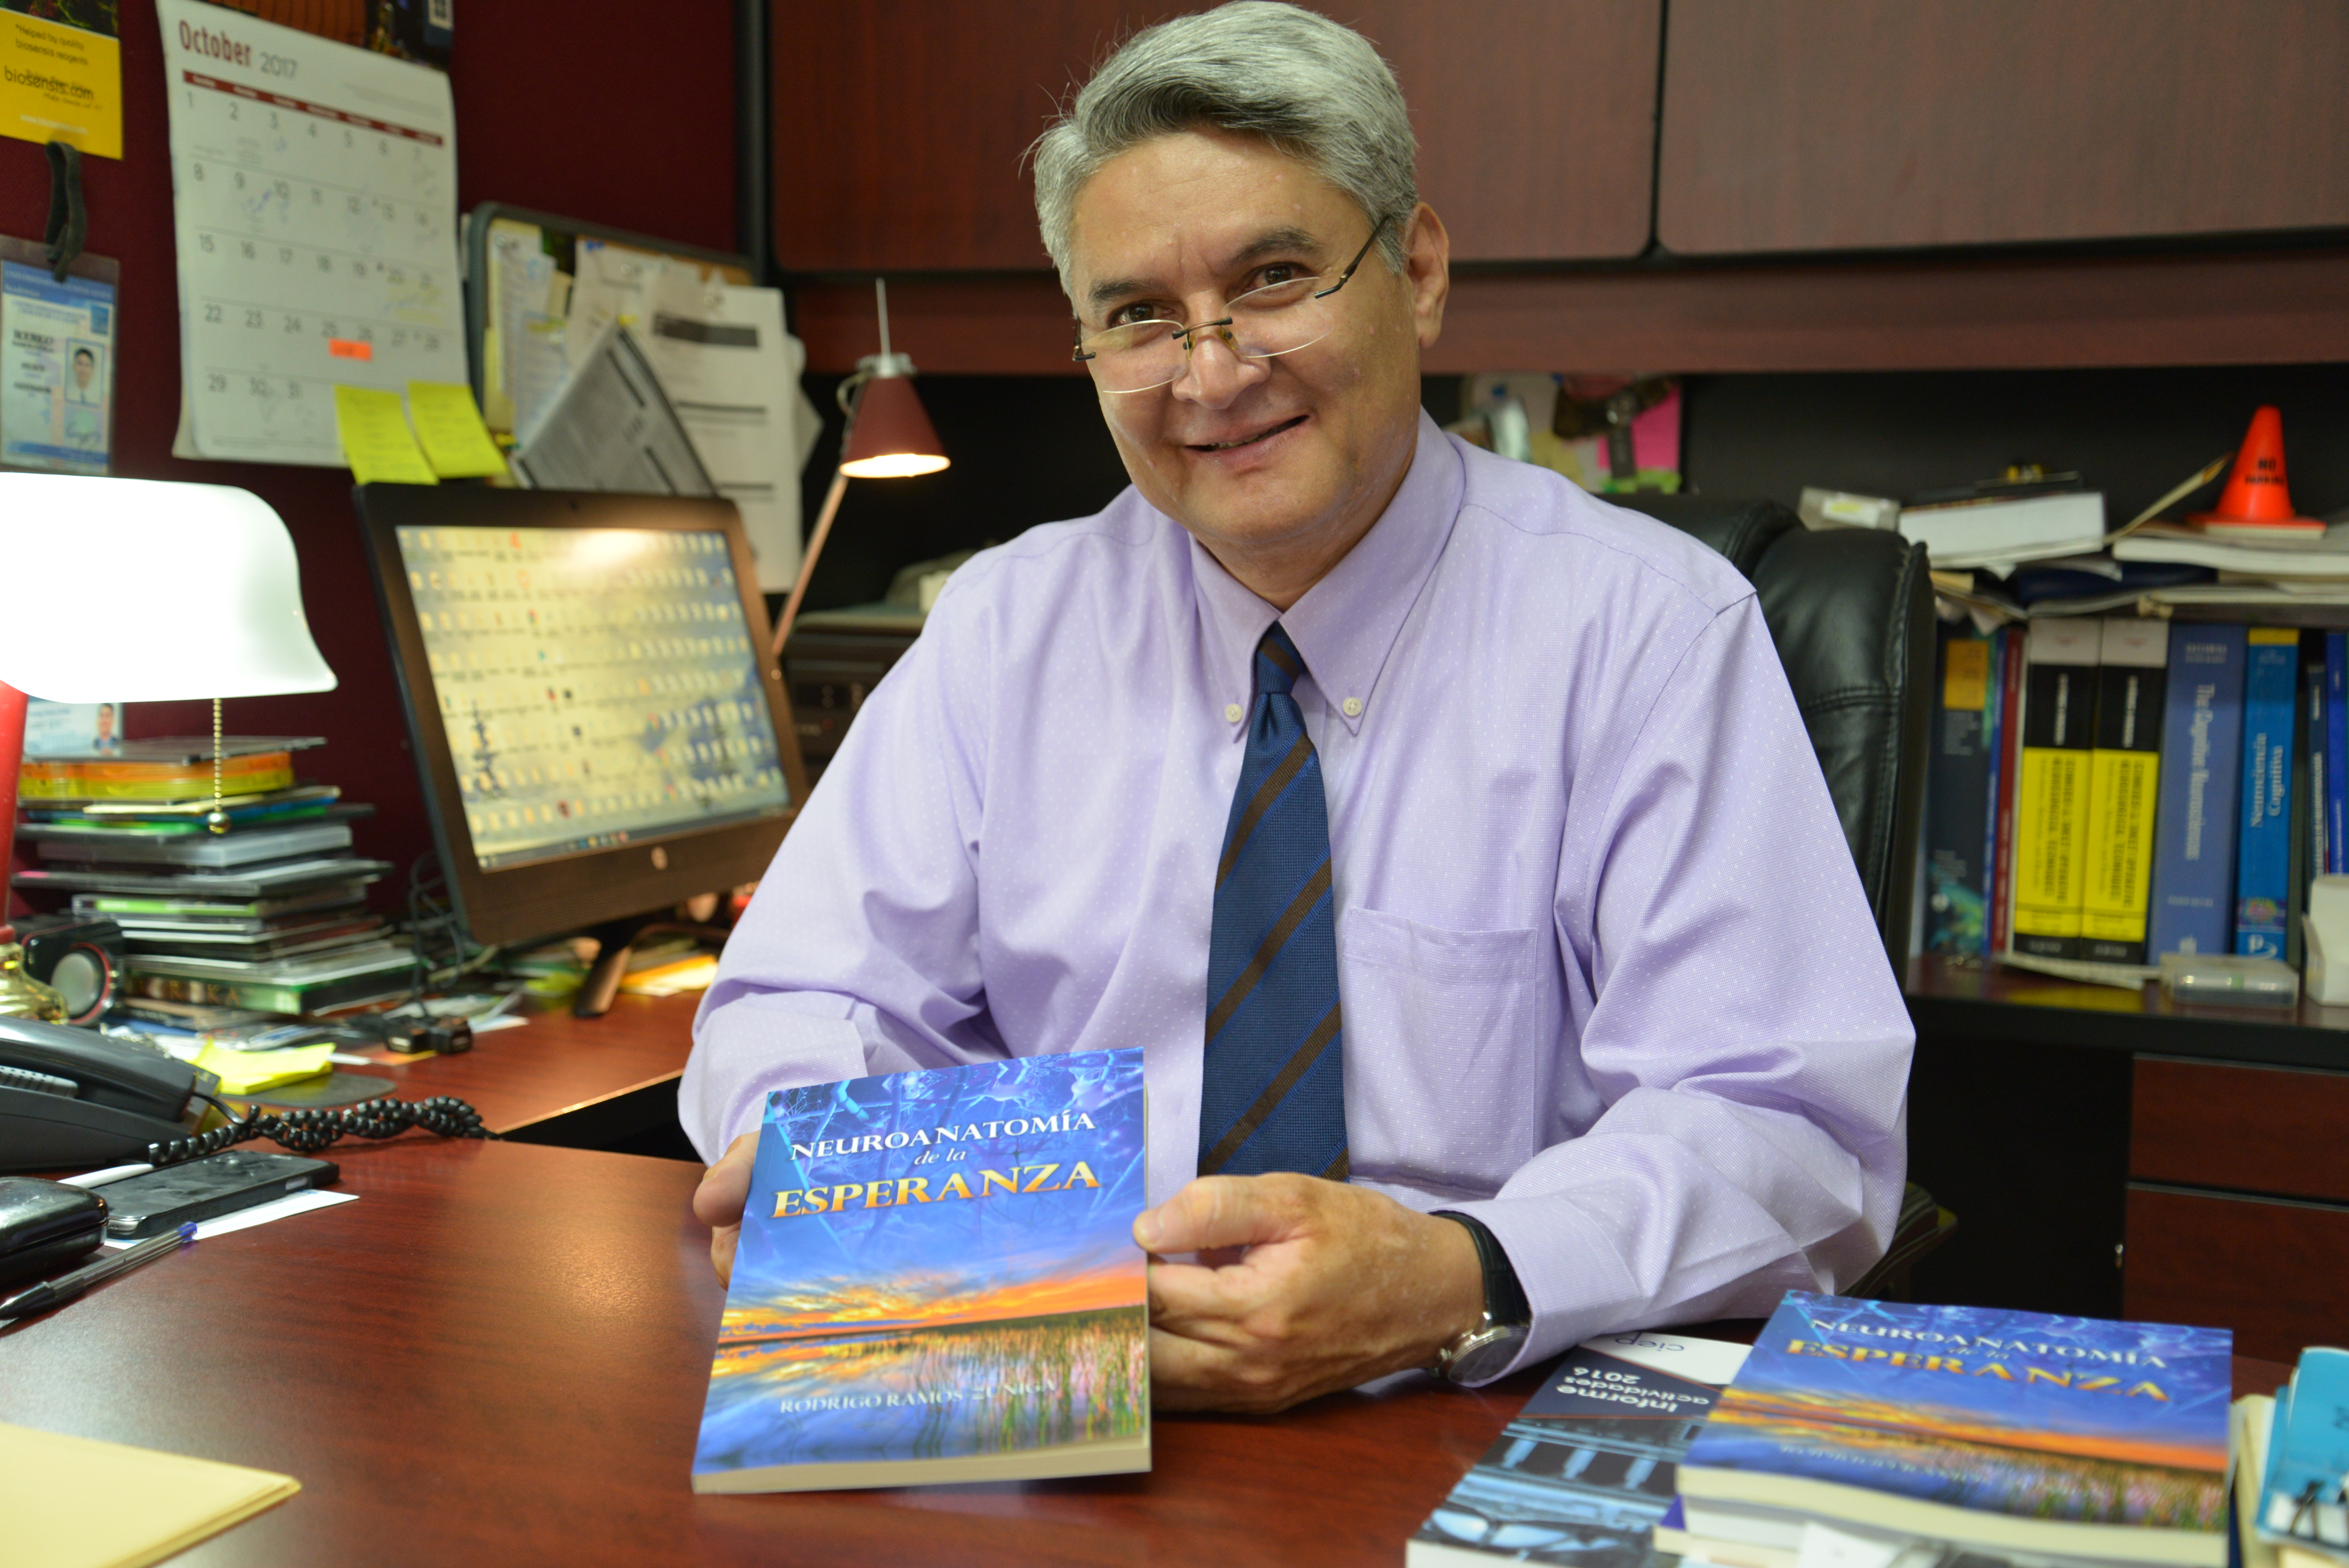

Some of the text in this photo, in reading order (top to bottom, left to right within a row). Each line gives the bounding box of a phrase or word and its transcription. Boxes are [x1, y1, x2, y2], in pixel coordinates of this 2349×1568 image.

[178, 19, 298, 78] October 2017
[186, 91, 194, 108] 1
[228, 101, 240, 121] 2
[269, 111, 279, 130] 3
[307, 122, 317, 137] 4
[194, 162, 205, 182] 8
[235, 171, 246, 190] 9
[274, 179, 290, 201] 10
[200, 233, 215, 253] 15
[203, 303, 223, 324] 22
[244, 309, 264, 330] 23
[283, 314, 303, 334] 24
[207, 372, 228, 392] 29
[2258, 456, 2276, 472] NO
[2268, 745, 2286, 816] Cognitiva
[790, 1109, 1096, 1161] NEUROANATOMÍA
[914, 1148, 967, 1165] de la
[770, 1160, 1102, 1219] ESPERANZA
[1615, 1332, 1685, 1352] ciep
[1573, 1367, 1641, 1384] 2016
[1786, 1339, 2170, 1402] ESPERANZA
[780, 1393, 882, 1414] RODRIGO
[1556, 1384, 1679, 1413] Informe
[1564, 1376, 1709, 1405] actividades
